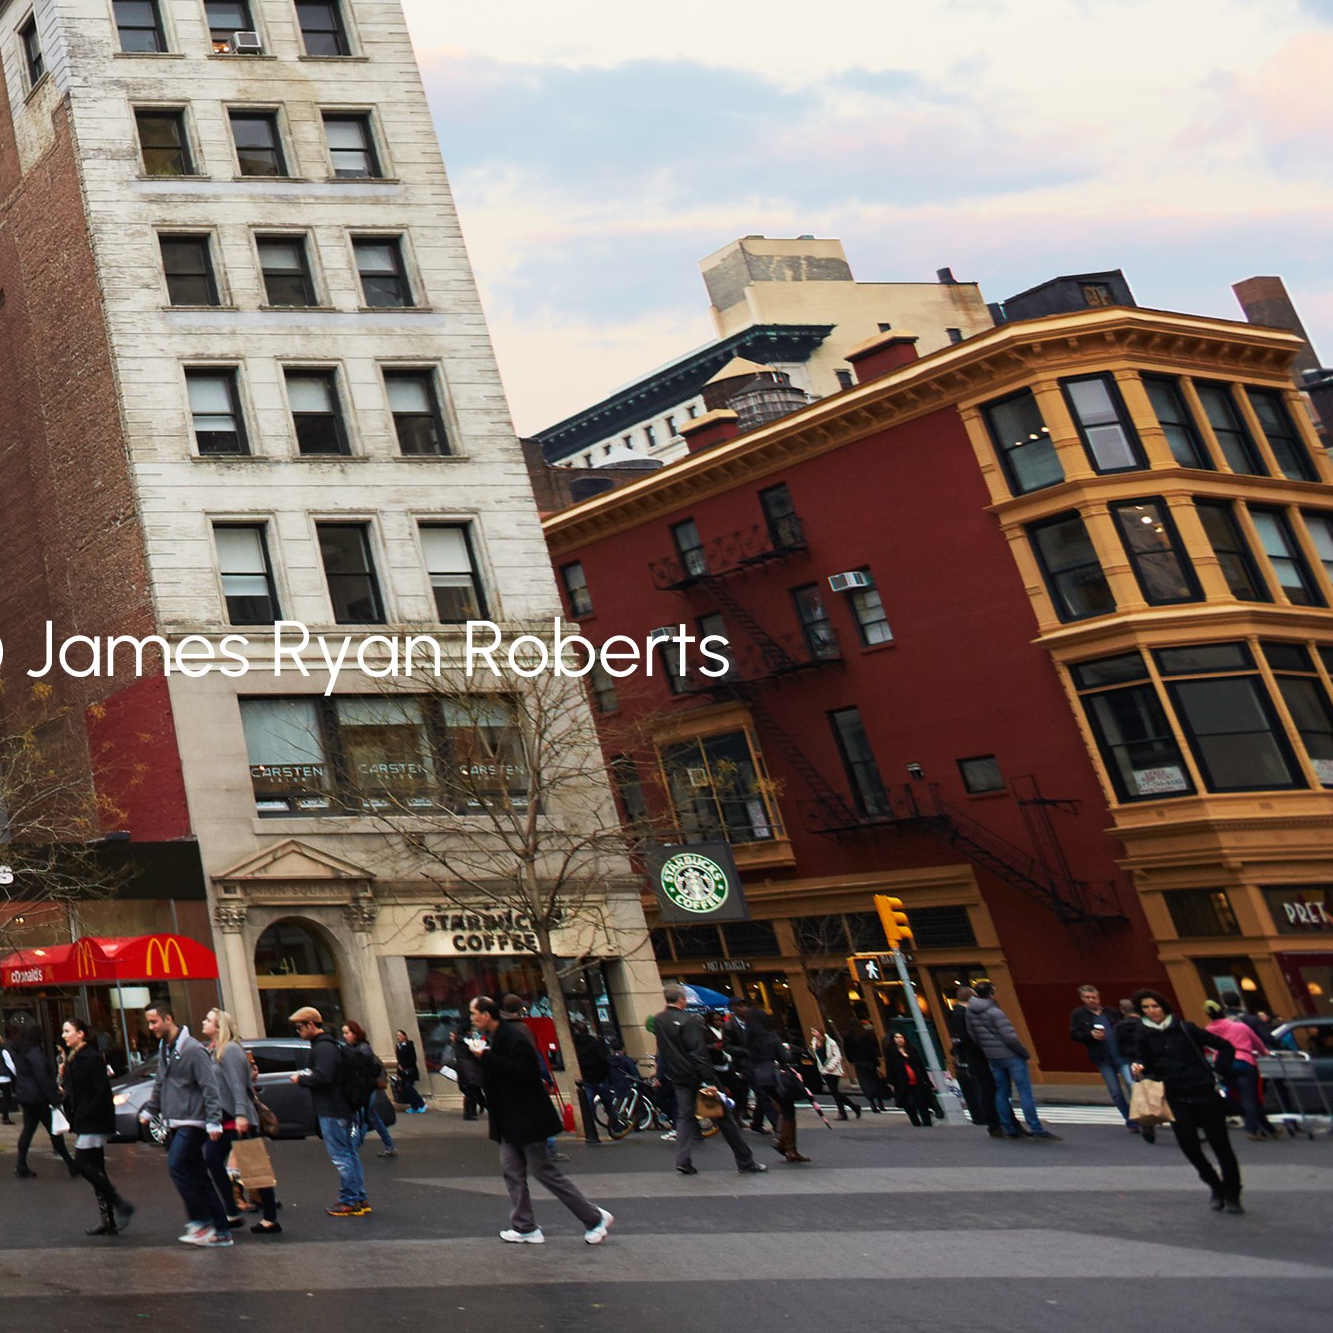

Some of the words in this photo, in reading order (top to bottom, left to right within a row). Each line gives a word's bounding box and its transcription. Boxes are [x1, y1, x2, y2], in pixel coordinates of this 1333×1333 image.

[251, 766, 324, 777] CARSTEN
[663, 856, 723, 883] STARBUCKS
[675, 892, 722, 910] COFFEE
[1283, 901, 1329, 925] PRET
[452, 933, 539, 952] COFFEE
[279, 956, 298, 975] 41
